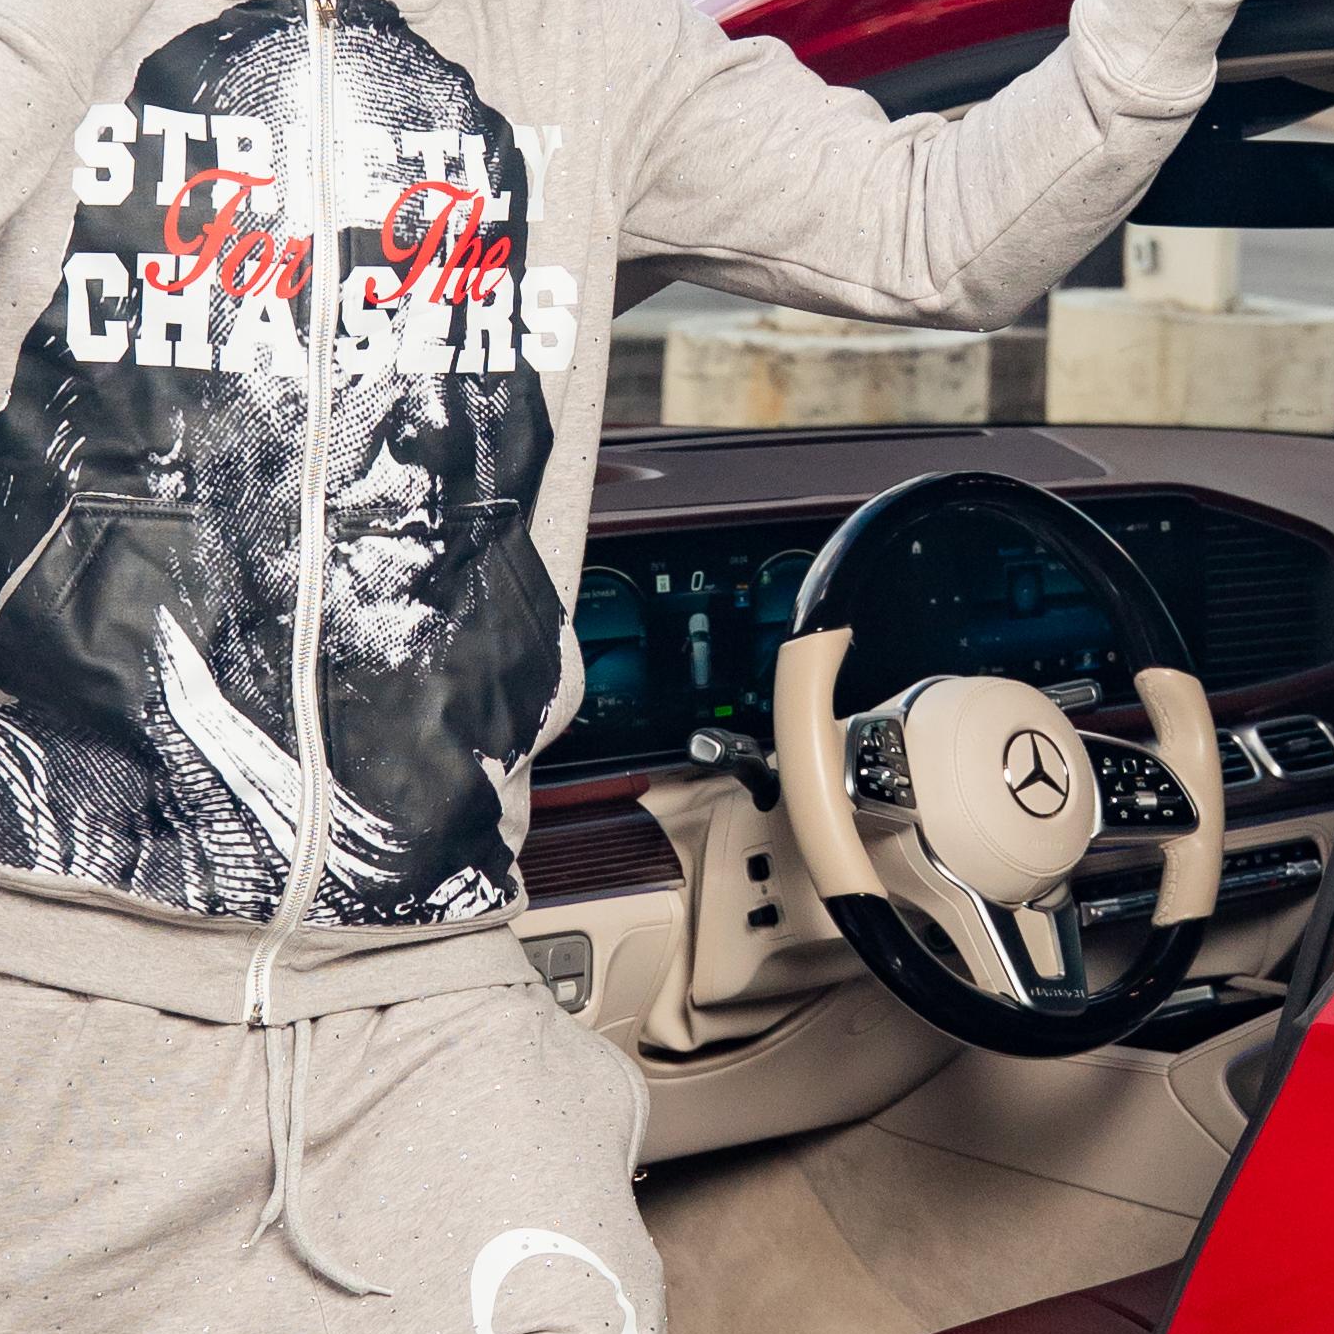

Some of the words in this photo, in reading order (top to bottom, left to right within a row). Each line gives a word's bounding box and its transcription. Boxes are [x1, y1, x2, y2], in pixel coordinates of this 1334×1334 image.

[145, 169, 314, 300] For
[365, 180, 512, 305] The
[64, 252, 578, 376] CHASERS
